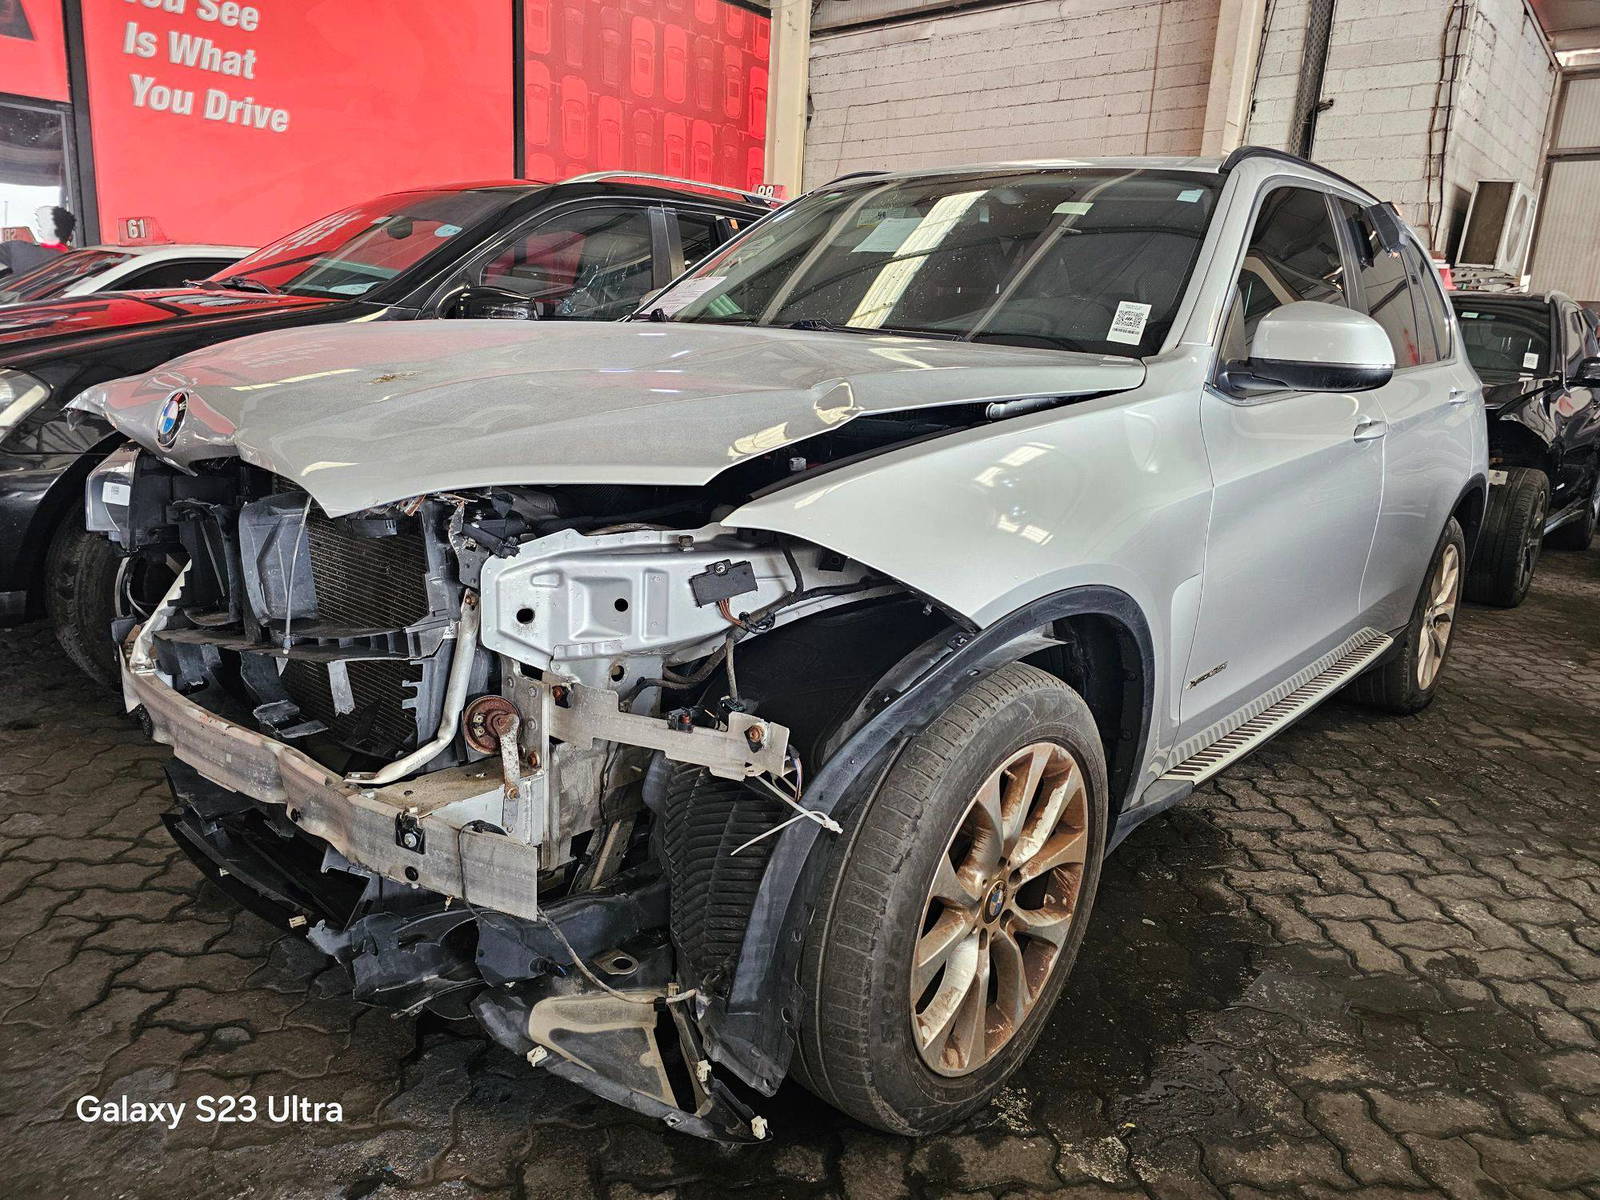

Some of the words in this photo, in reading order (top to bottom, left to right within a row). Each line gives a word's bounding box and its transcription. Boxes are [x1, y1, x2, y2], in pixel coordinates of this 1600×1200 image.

[196, 0, 259, 32] See
[123, 22, 158, 58] Is
[168, 31, 257, 80] What
[130, 73, 194, 116] You
[204, 88, 289, 133] Drive
[127, 219, 146, 239] 61
